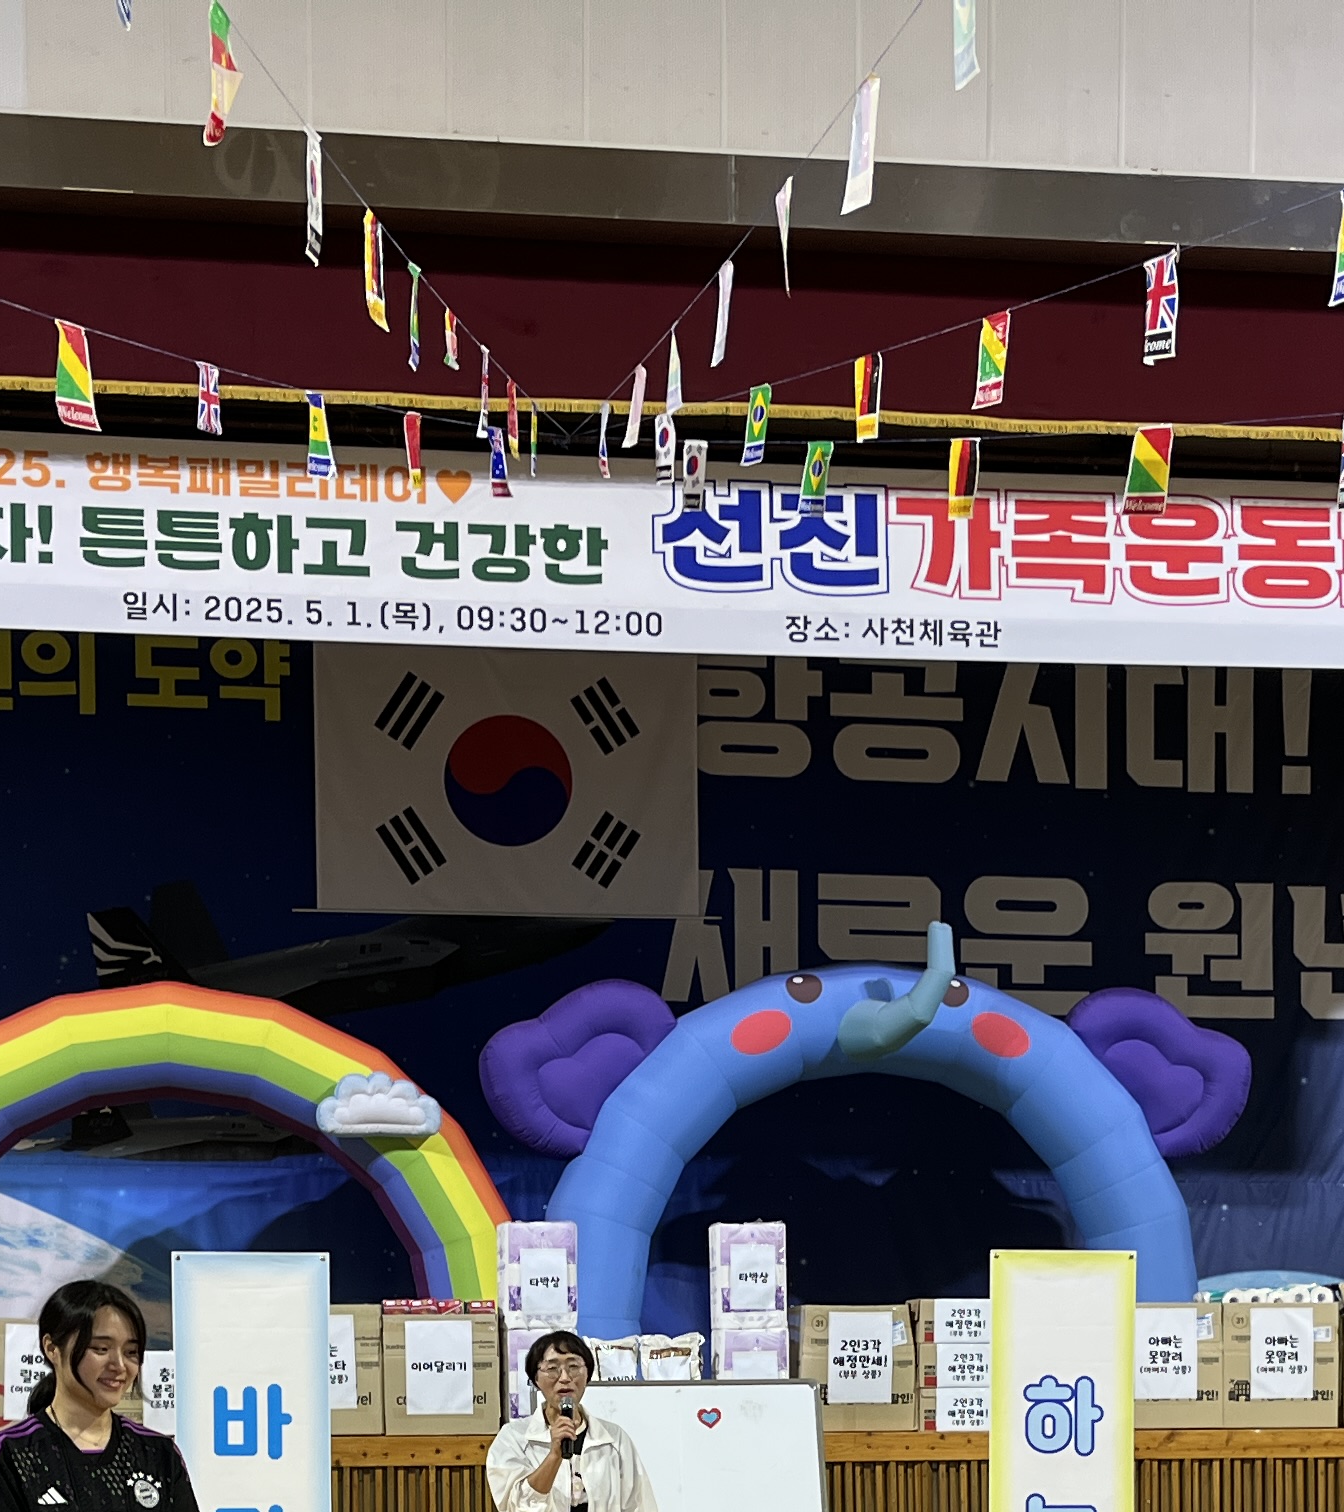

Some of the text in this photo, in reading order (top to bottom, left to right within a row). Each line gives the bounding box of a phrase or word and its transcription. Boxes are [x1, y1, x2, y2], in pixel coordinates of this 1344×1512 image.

[57, 405, 95, 423] Welcome
[85, 450, 430, 505] 행복패밀리데이
[1126, 499, 1164, 512] Welcome
[79, 504, 372, 579] 튼튼하고
[396, 516, 610, 586] 건강한
[654, 482, 890, 596] 선진
[122, 591, 193, 624] 일시:
[203, 596, 295, 627] 2025.
[304, 600, 335, 628] 5.
[456, 605, 663, 638] 09:30~12:00
[785, 615, 852, 645] 장소:
[861, 617, 1003, 651] 사천체육관
[126, 634, 291, 723] 도약
[530, 1275, 560, 1288] 타박상
[739, 1271, 769, 1284] 타박상
[840, 1339, 882, 1354] 2인3각
[1148, 1335, 1183, 1348] 아빠는
[1265, 1335, 1299, 1348] 아빠는
[832, 1355, 888, 1369] 애정만세!
[1149, 1350, 1183, 1365] 못말려
[1265, 1350, 1299, 1364] 못말려
[411, 1360, 467, 1373] 이어달리기
